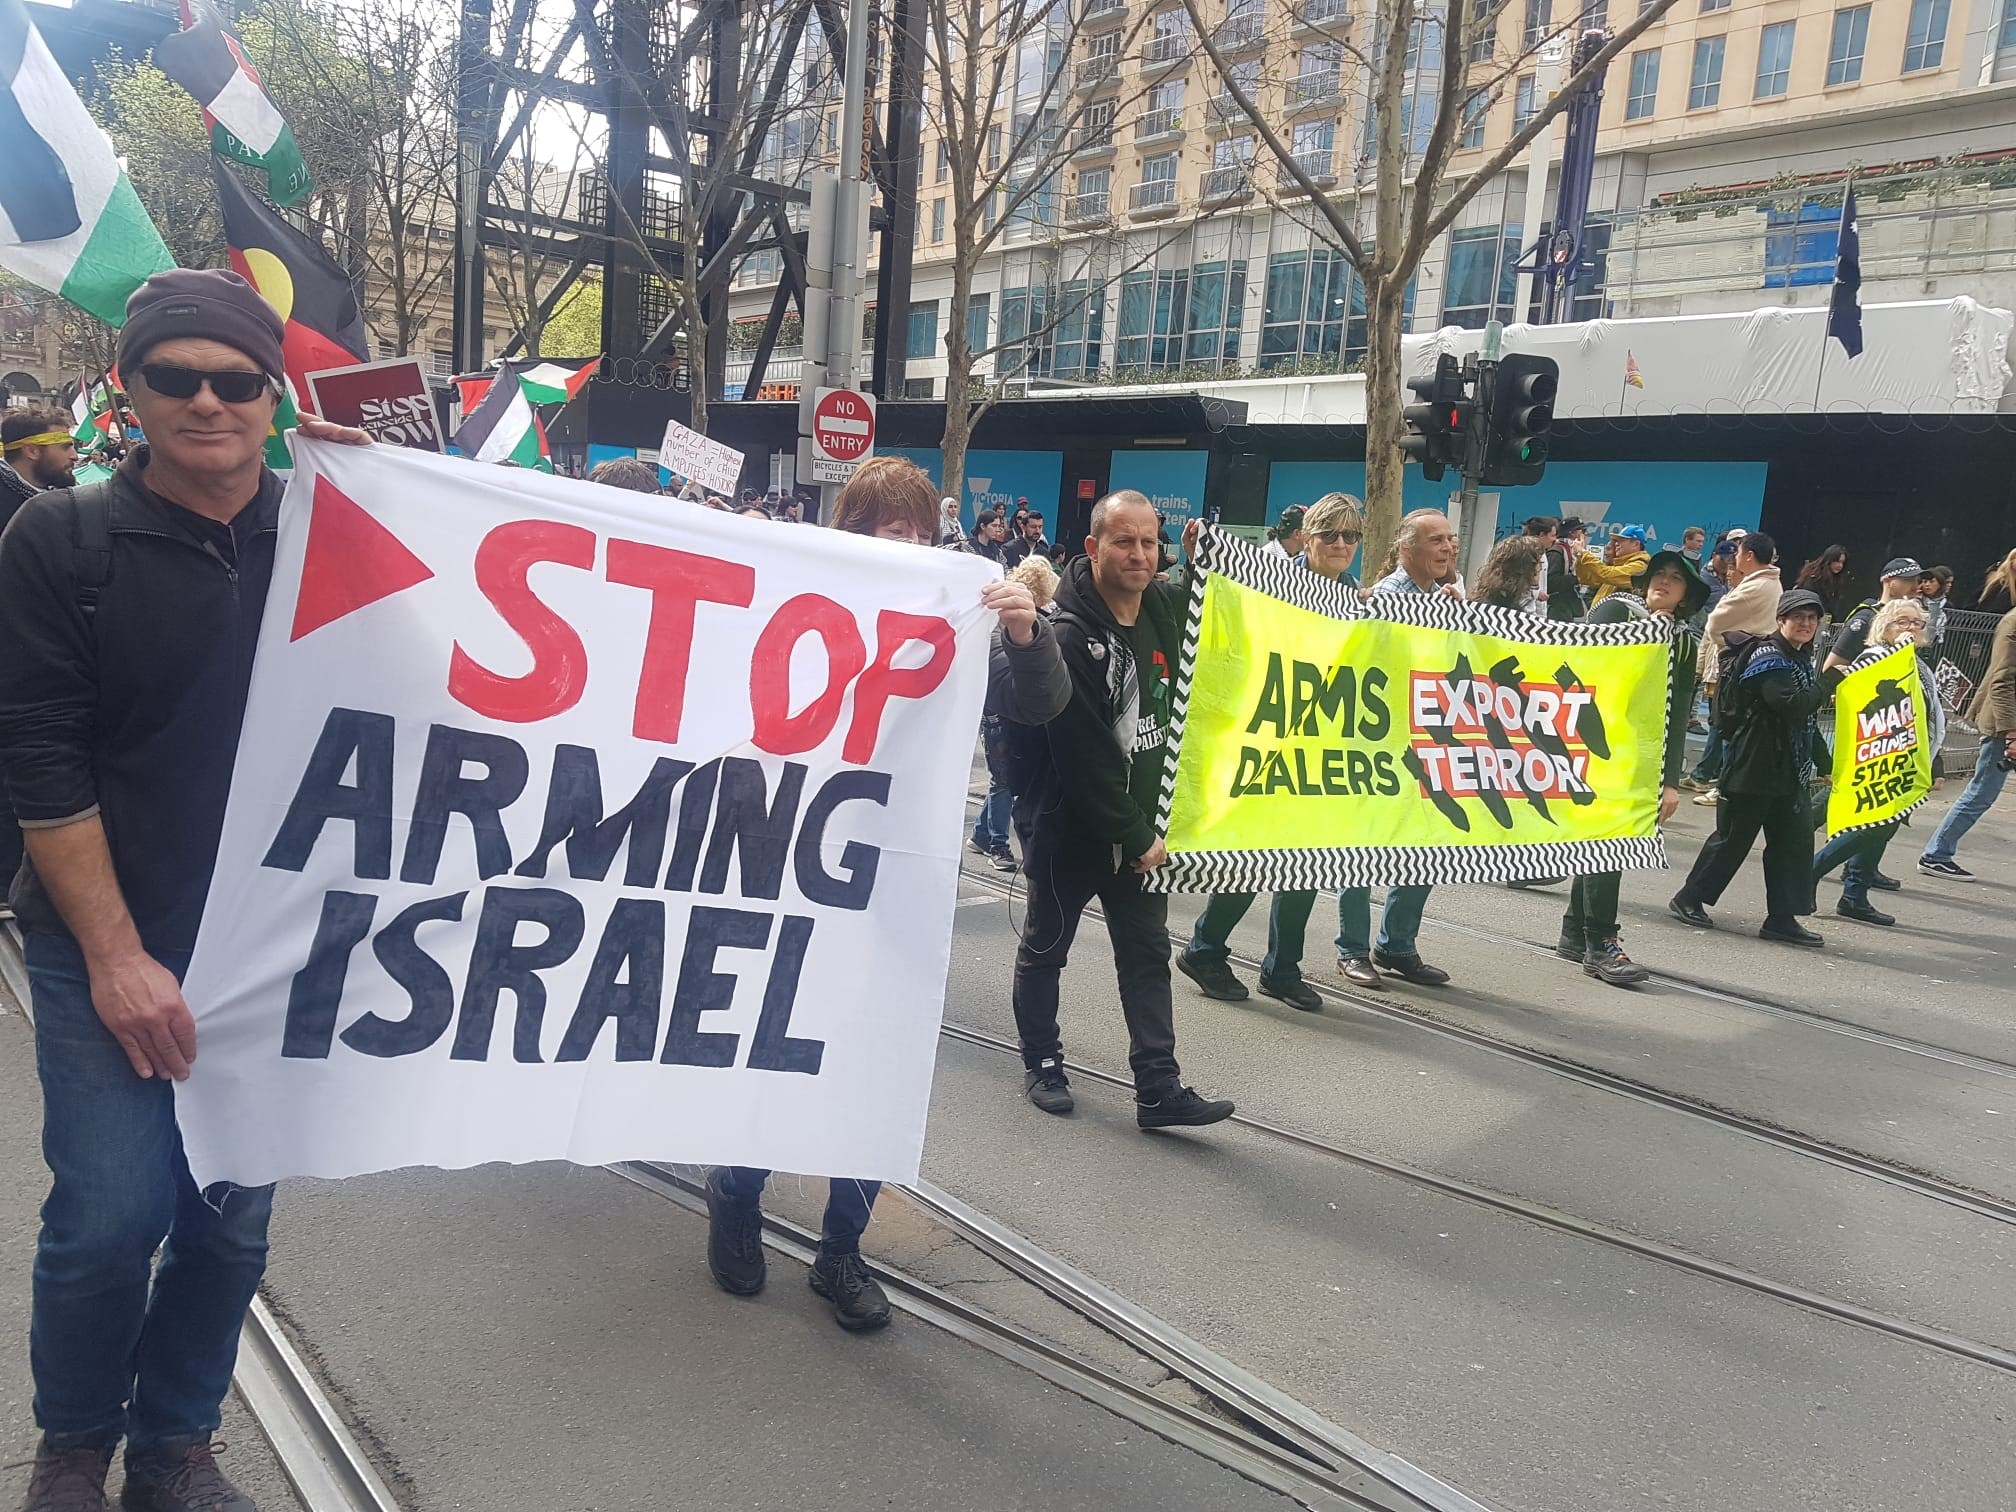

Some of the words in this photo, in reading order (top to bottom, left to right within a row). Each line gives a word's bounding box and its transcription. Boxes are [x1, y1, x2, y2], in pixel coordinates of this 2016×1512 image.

[360, 394, 431, 421] Stop
[836, 400, 855, 416] NO
[672, 425, 707, 451] GAZA
[822, 434, 865, 452] ENTRY
[666, 439, 700, 461] number
[704, 457, 714, 468] of
[716, 463, 738, 478] CHILD
[814, 461, 842, 472] BICYCLES
[824, 472, 850, 481] EXCEPT
[1152, 494, 1192, 512] trains,
[447, 518, 956, 765] STOP
[1245, 651, 1391, 742] ARMS
[1413, 678, 1592, 738] EXPORT
[1137, 713, 1157, 734] REE
[1858, 696, 1914, 738] WAR
[1857, 727, 1917, 762] CRIMES
[1416, 745, 1593, 793] TERROR!
[1851, 746, 1918, 787] START
[261, 706, 893, 911] ARMING
[1854, 770, 1918, 814] HERE
[281, 886, 826, 1075] ISRAEL
